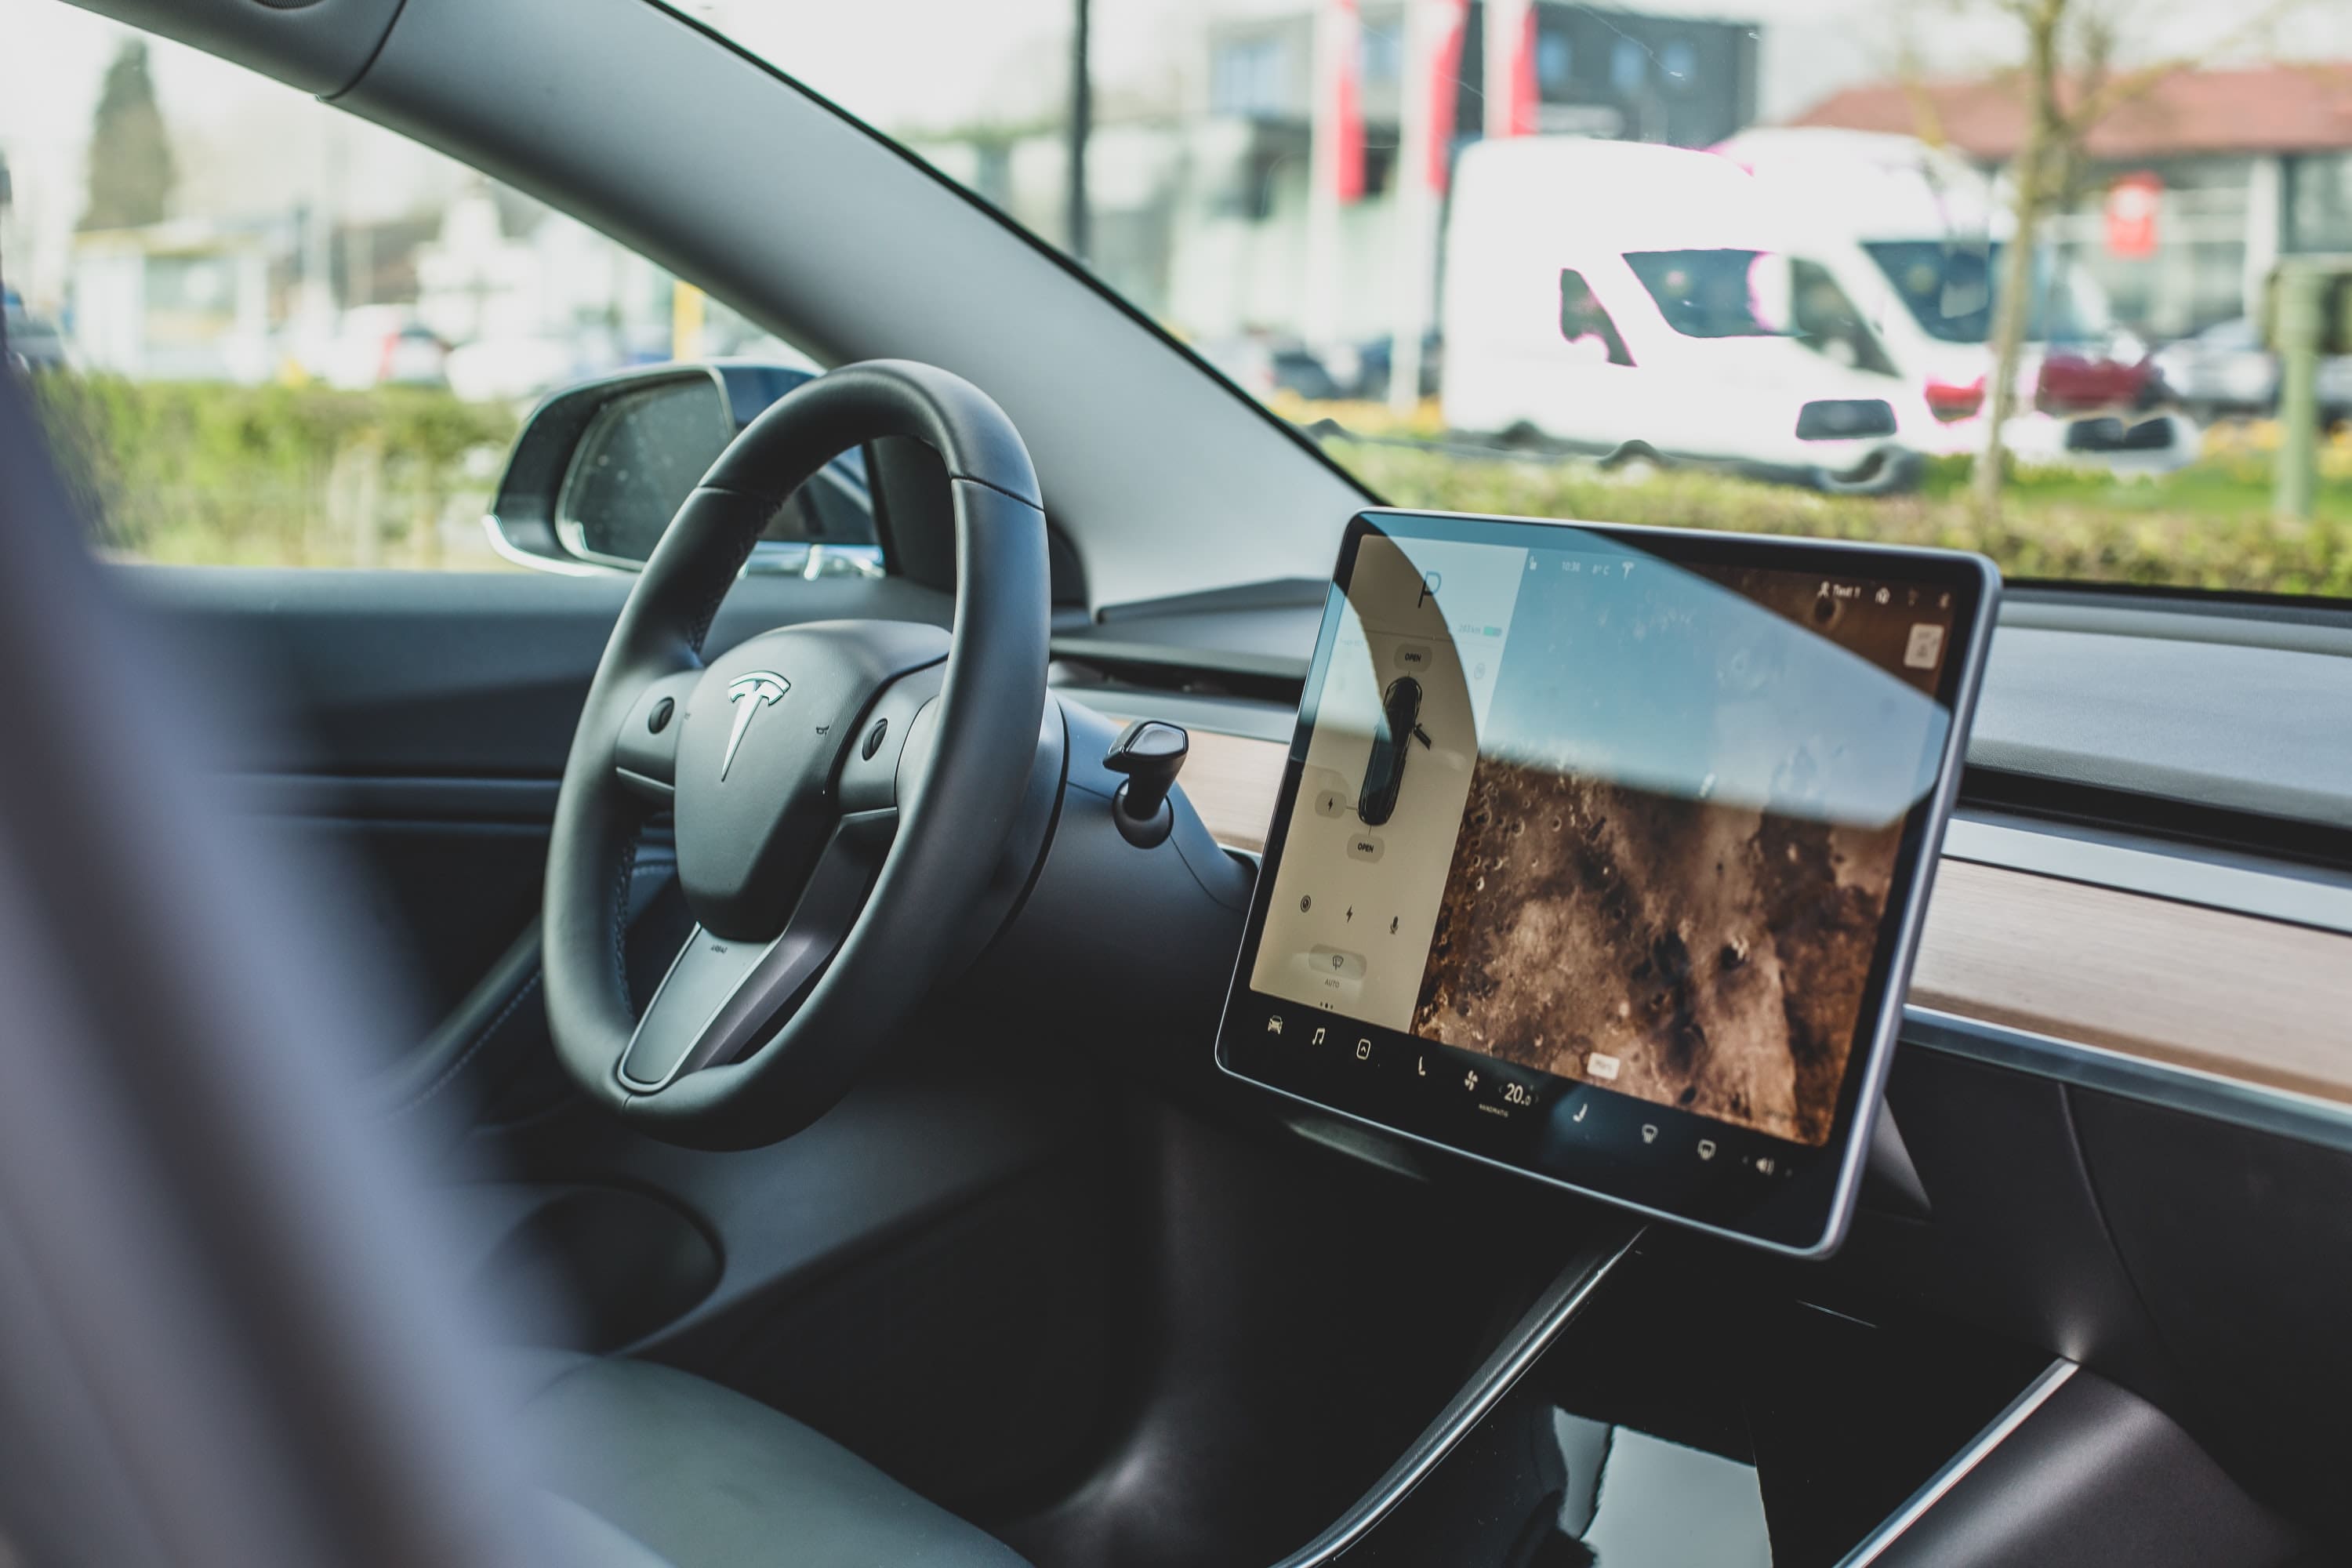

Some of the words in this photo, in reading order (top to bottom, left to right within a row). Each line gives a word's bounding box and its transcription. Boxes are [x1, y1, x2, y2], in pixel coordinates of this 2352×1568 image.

[1417, 571, 1442, 608] P
[1404, 652, 1422, 663] OPEN
[1357, 842, 1374, 853] OPEN
[1324, 978, 1340, 989] AUTO
